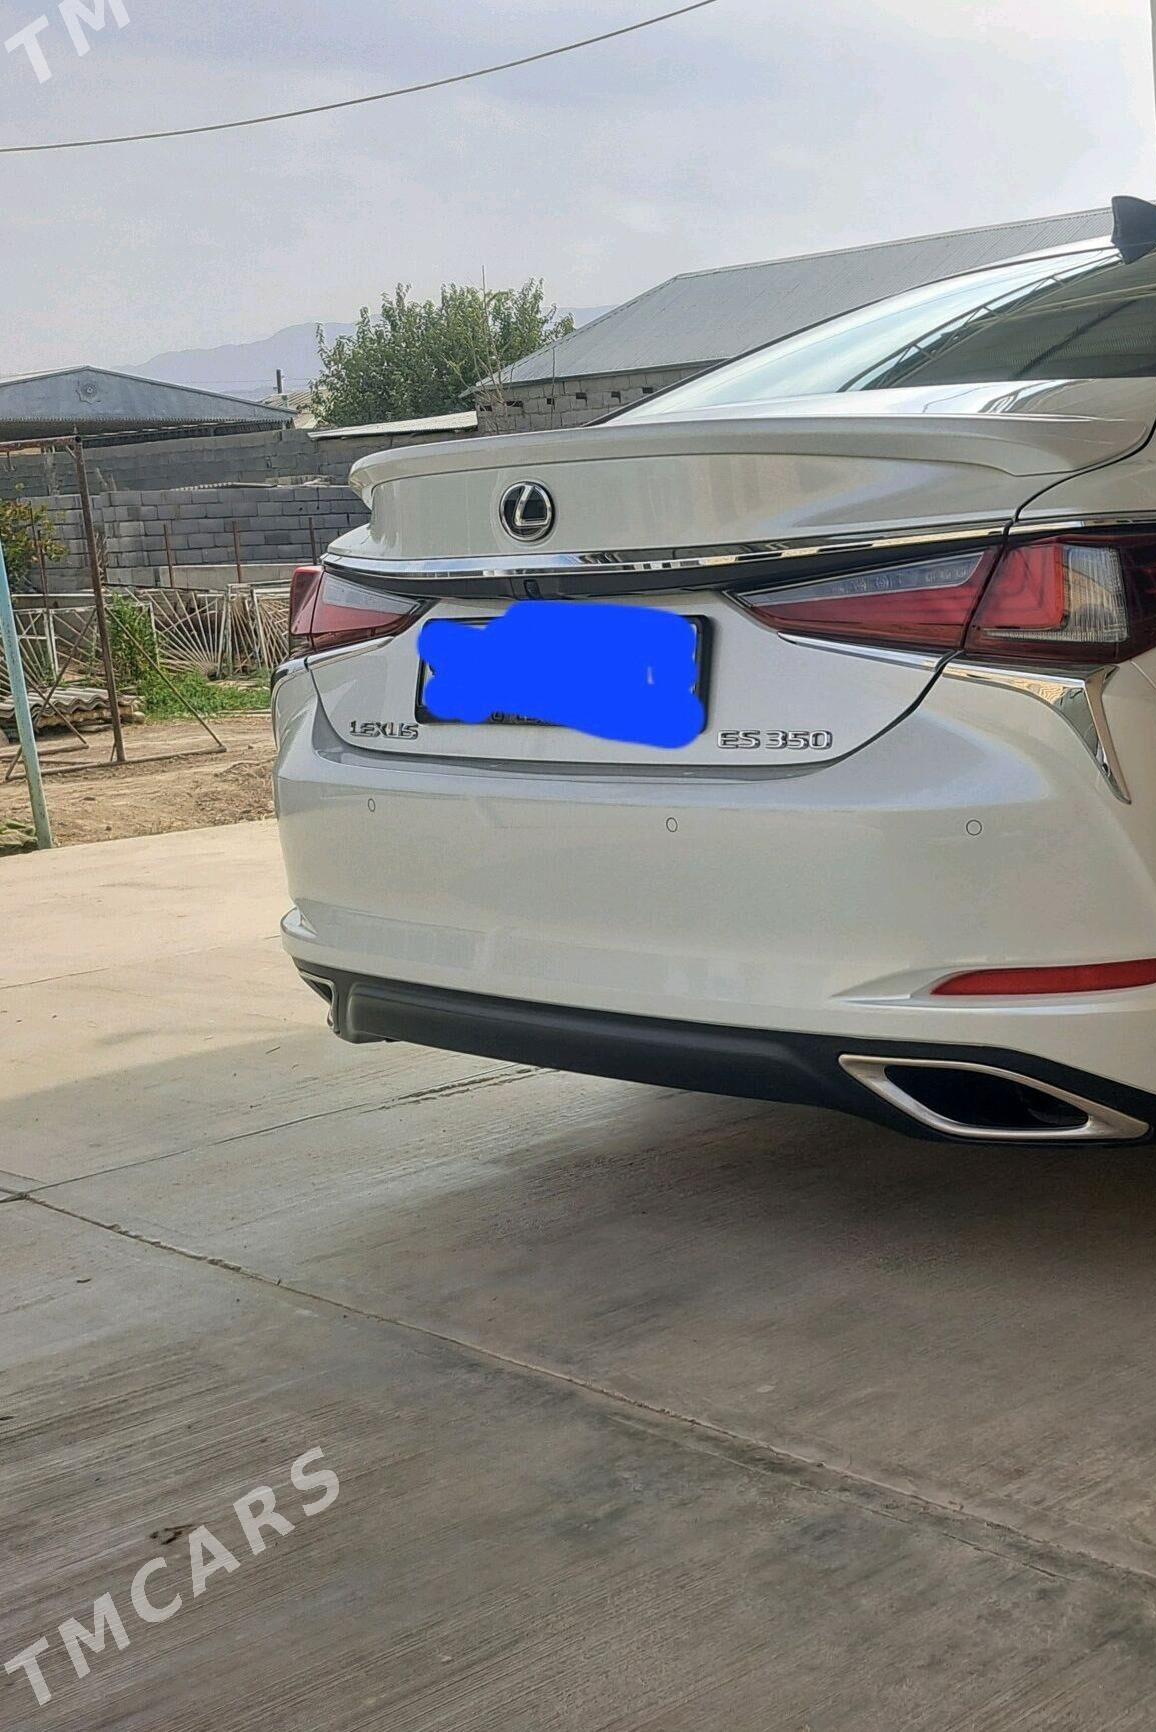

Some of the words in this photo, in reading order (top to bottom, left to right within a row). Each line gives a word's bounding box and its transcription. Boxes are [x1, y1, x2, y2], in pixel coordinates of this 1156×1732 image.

[349, 720, 419, 741] LEXUS
[717, 730, 761, 749] ES
[765, 729, 833, 750] 350
